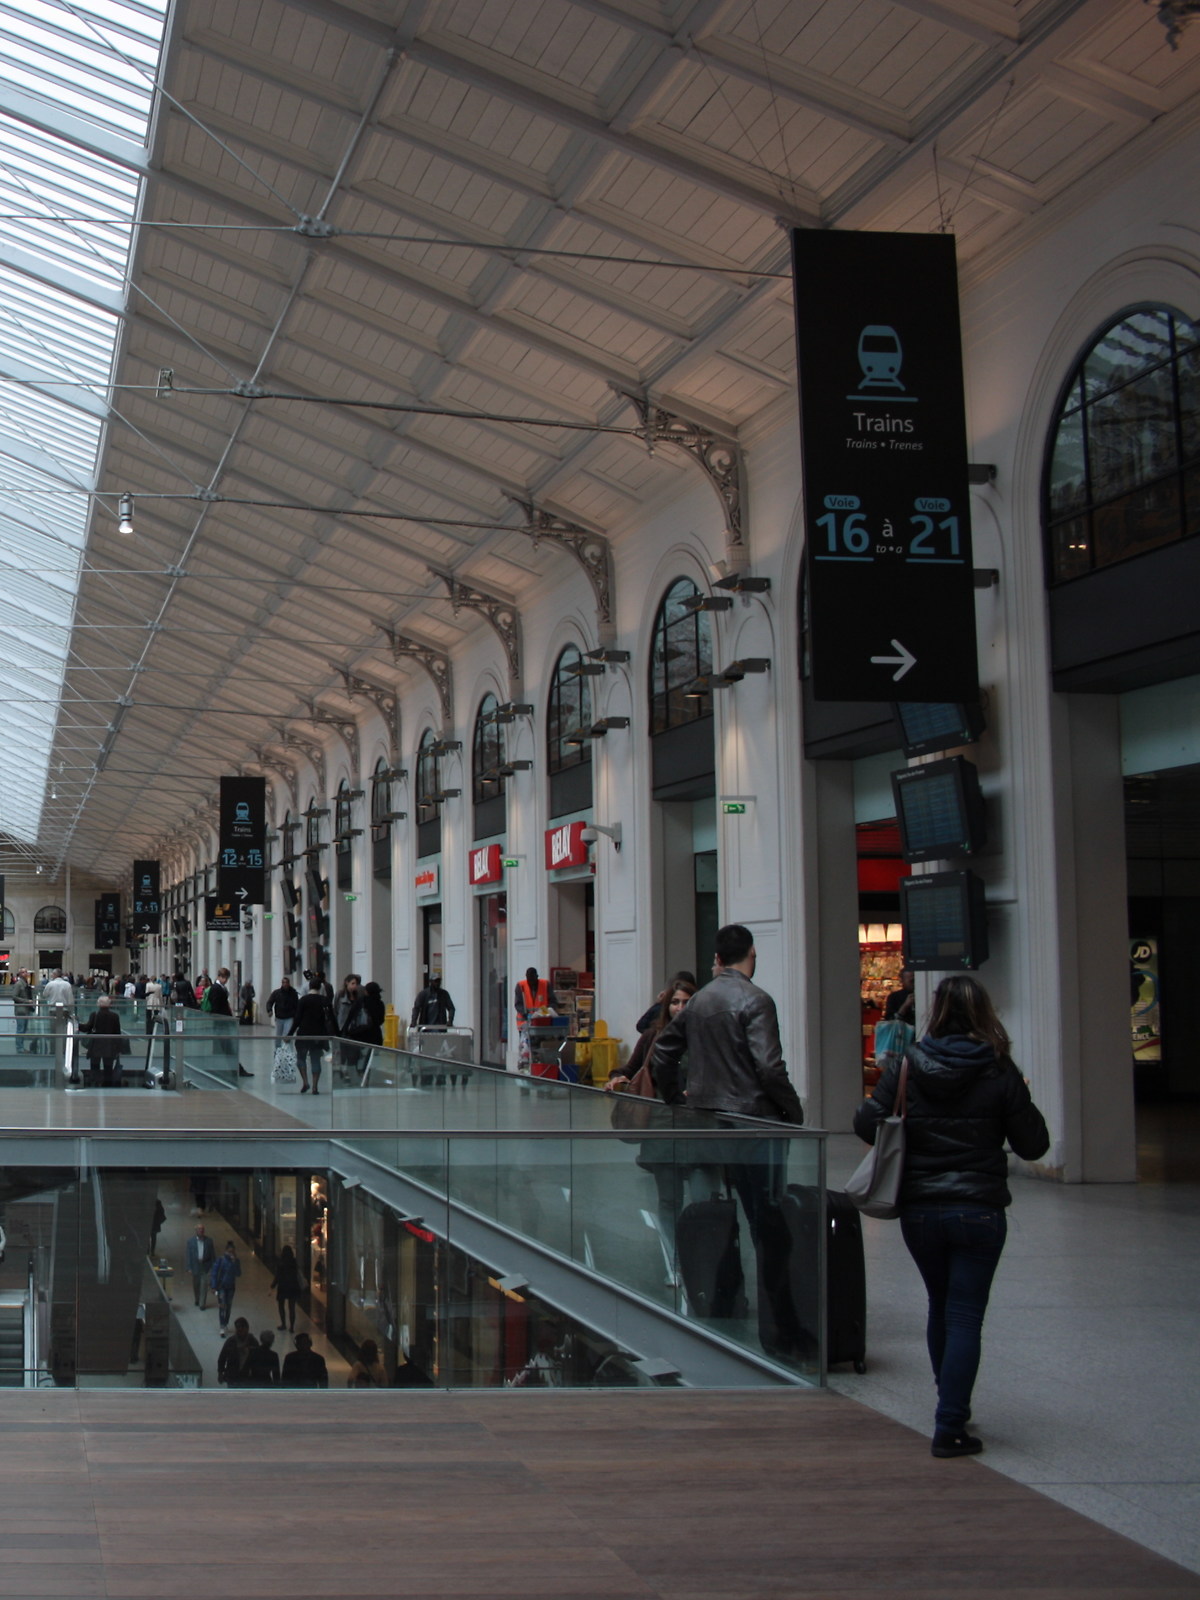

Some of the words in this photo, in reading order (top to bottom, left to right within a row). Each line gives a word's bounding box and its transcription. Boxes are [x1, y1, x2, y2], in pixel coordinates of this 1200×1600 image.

[852, 412, 915, 434] Trains
[845, 437, 878, 450] Trains
[888, 439, 924, 451] Trenes
[828, 496, 856, 509] Voie
[919, 499, 947, 512] Voie
[815, 512, 870, 554] 16
[881, 518, 894, 538] à
[908, 515, 961, 556] 21
[875, 543, 887, 555] to
[232, 825, 252, 834] Trains
[550, 823, 570, 866] RELAY
[222, 853, 237, 865] 12
[247, 854, 263, 866] 15
[473, 846, 490, 881] RELAY
[148, 904, 158, 912] 11
[1132, 946, 1150, 959] JD
